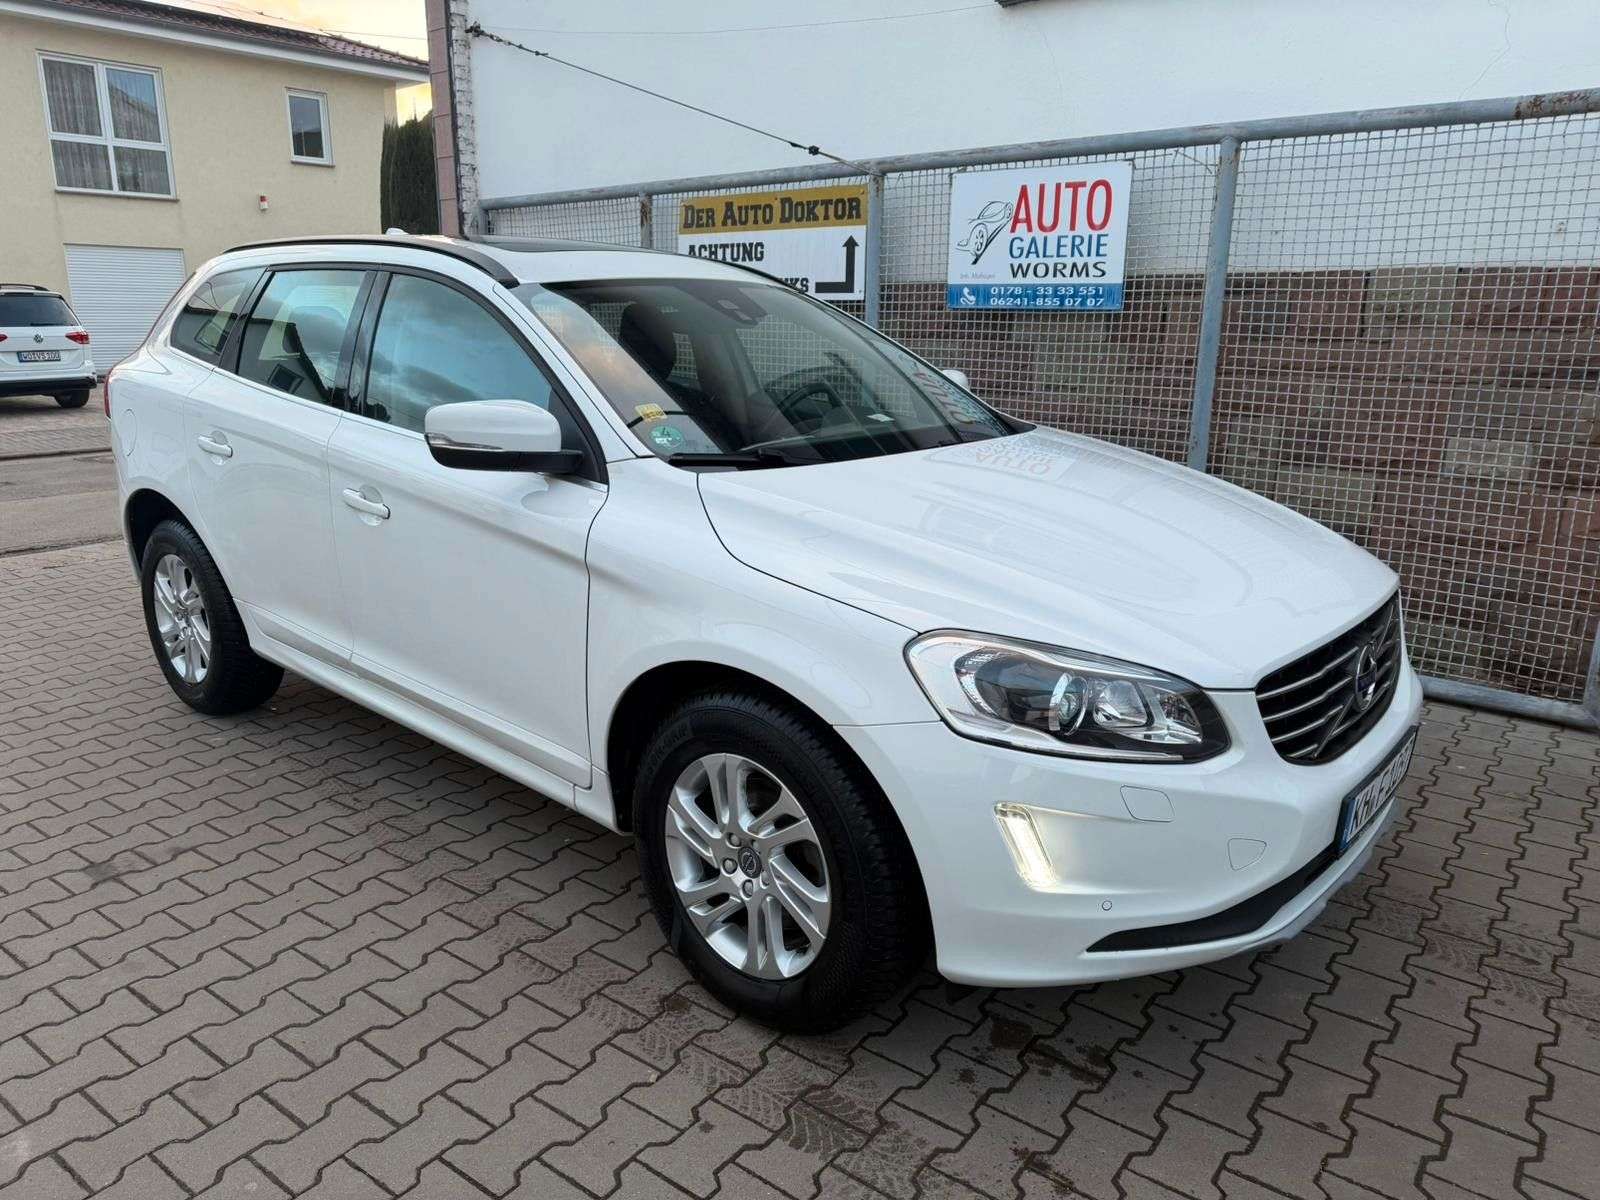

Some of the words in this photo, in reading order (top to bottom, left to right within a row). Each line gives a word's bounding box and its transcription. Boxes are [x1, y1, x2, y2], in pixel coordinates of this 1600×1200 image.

[683, 205, 715, 228] DER
[721, 201, 774, 227] AUTO
[779, 197, 862, 223] DOKTOR
[1009, 179, 1113, 233] AUTO
[1009, 233, 1109, 259] GALERIE
[1010, 261, 1107, 279] WORMS
[990, 286, 1023, 295] 0178
[1036, 286, 1053, 295] 33
[1057, 286, 1074, 295] 33
[1078, 286, 1104, 295] 551
[1065, 297, 1082, 306] 07
[1086, 297, 1105, 306] 07
